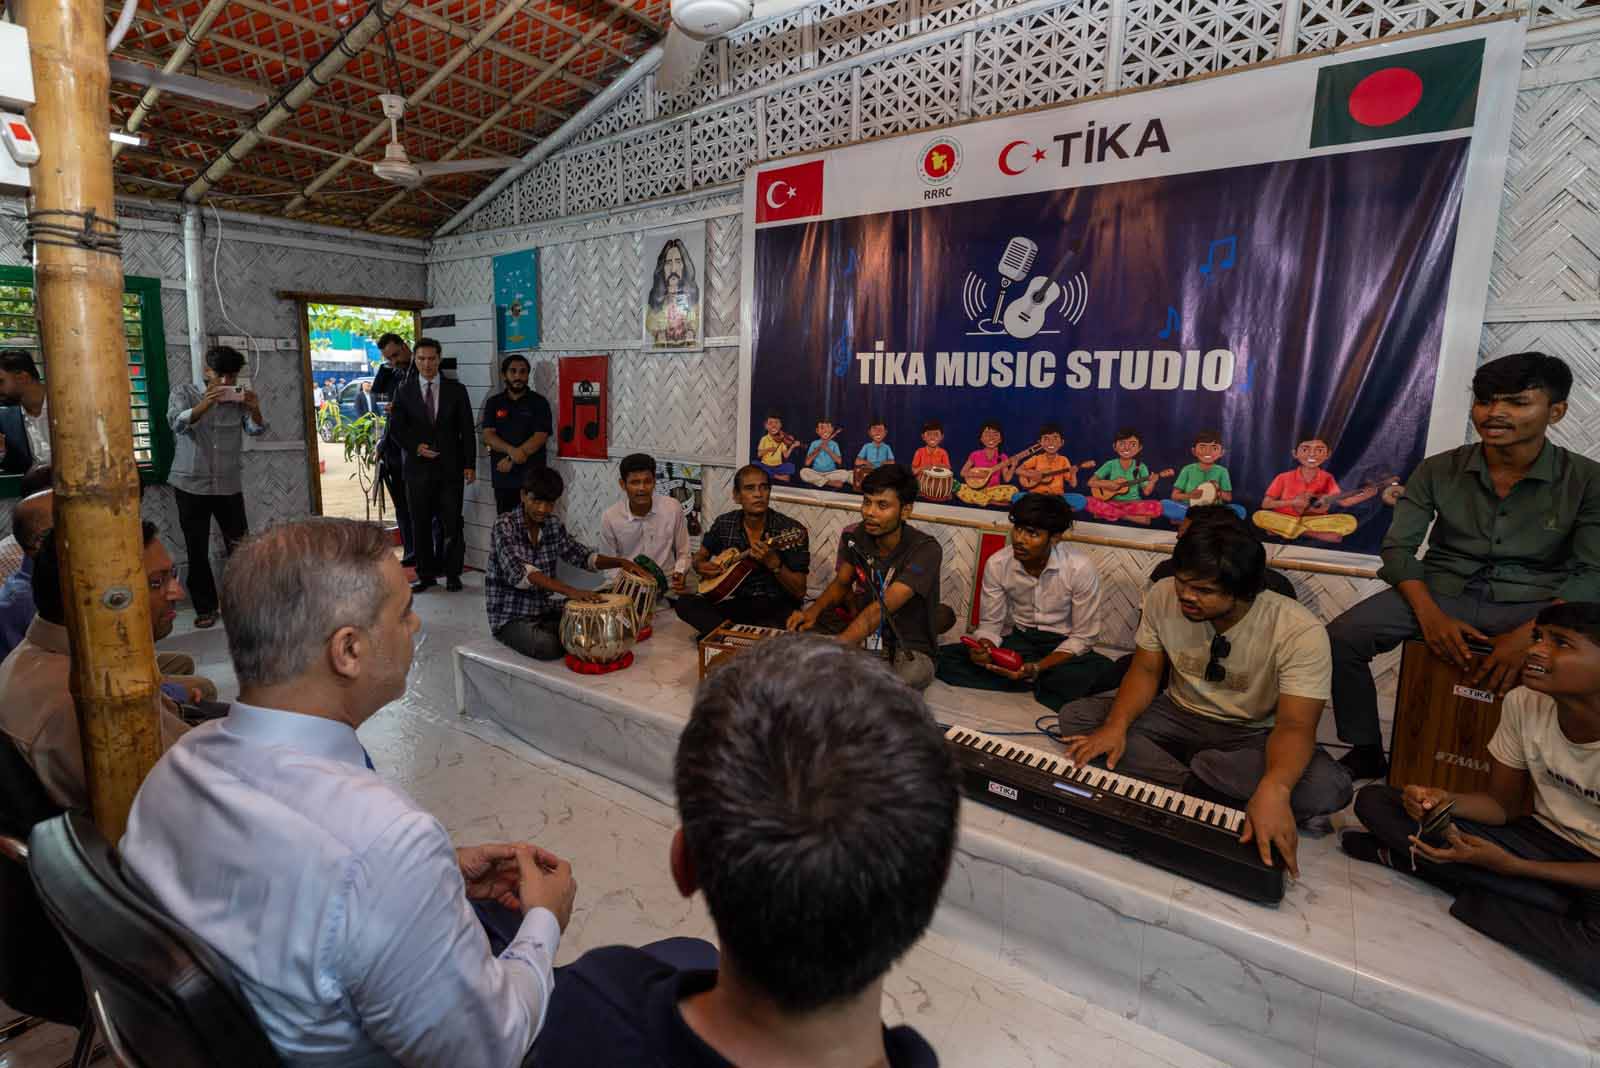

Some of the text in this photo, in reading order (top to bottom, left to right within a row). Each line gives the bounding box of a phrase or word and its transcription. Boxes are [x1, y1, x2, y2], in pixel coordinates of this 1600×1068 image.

[1053, 118, 1171, 168] TİKA
[923, 186, 953, 201] RRRC
[856, 341, 1235, 392] TİKA MUSIC STUDIO
